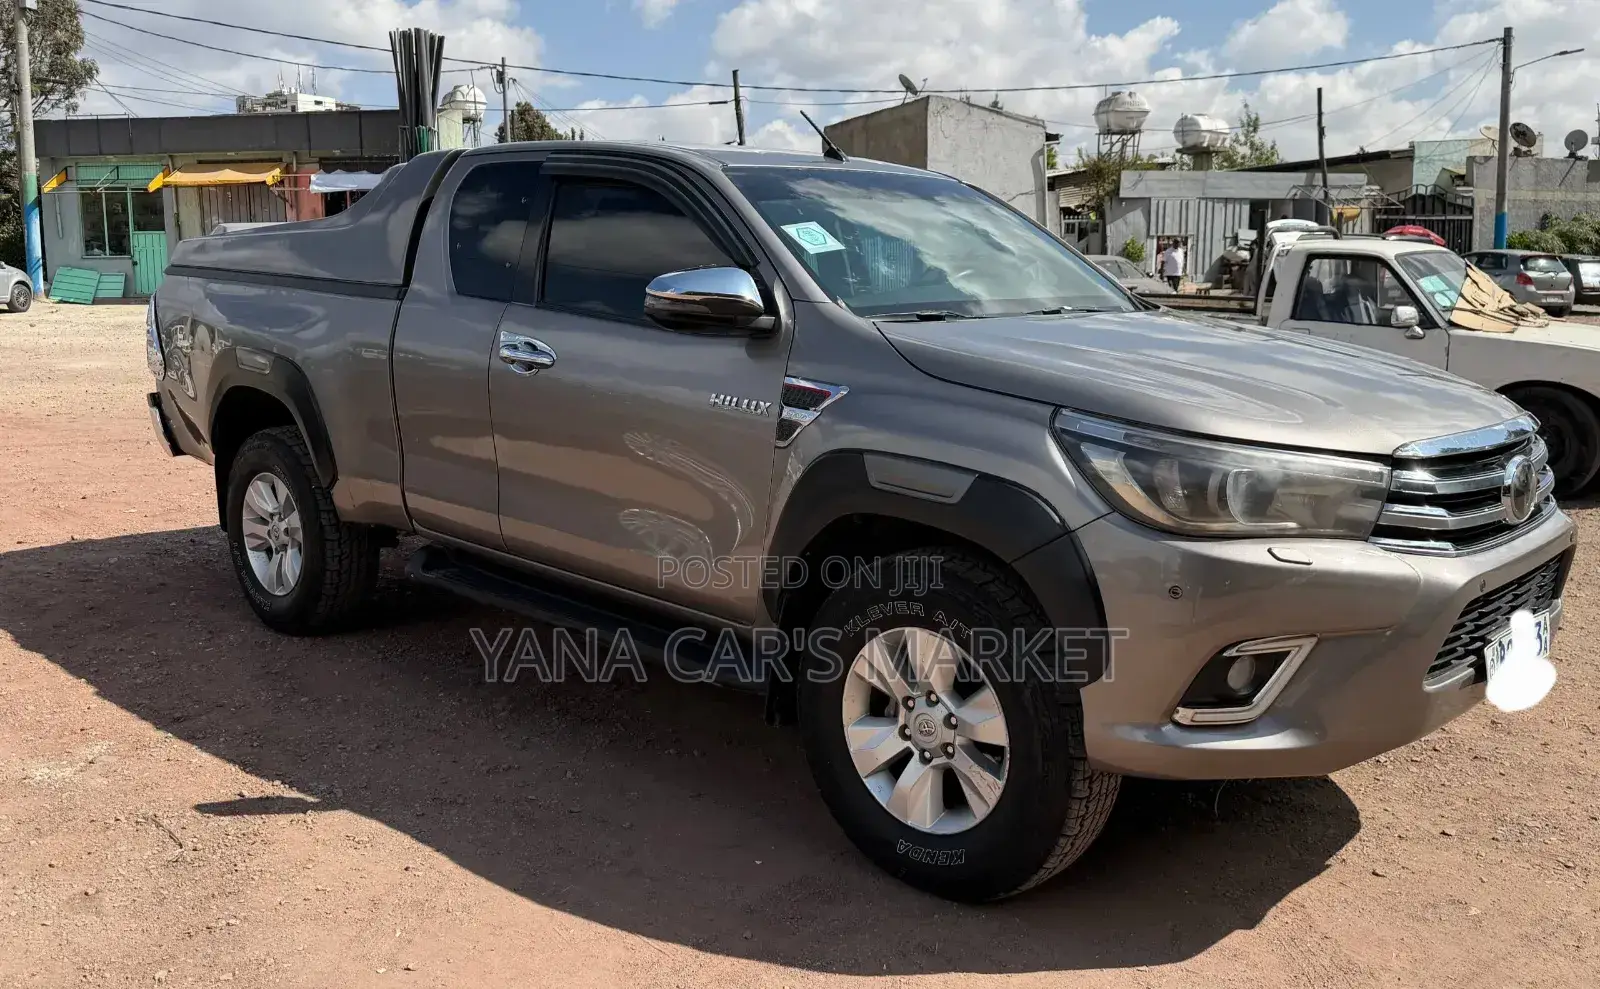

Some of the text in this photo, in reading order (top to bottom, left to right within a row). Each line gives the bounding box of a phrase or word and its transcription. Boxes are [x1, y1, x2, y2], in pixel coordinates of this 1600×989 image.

[709, 393, 772, 417] HILUX
[843, 601, 925, 637] KLEVER
[896, 839, 966, 866] KENDA
